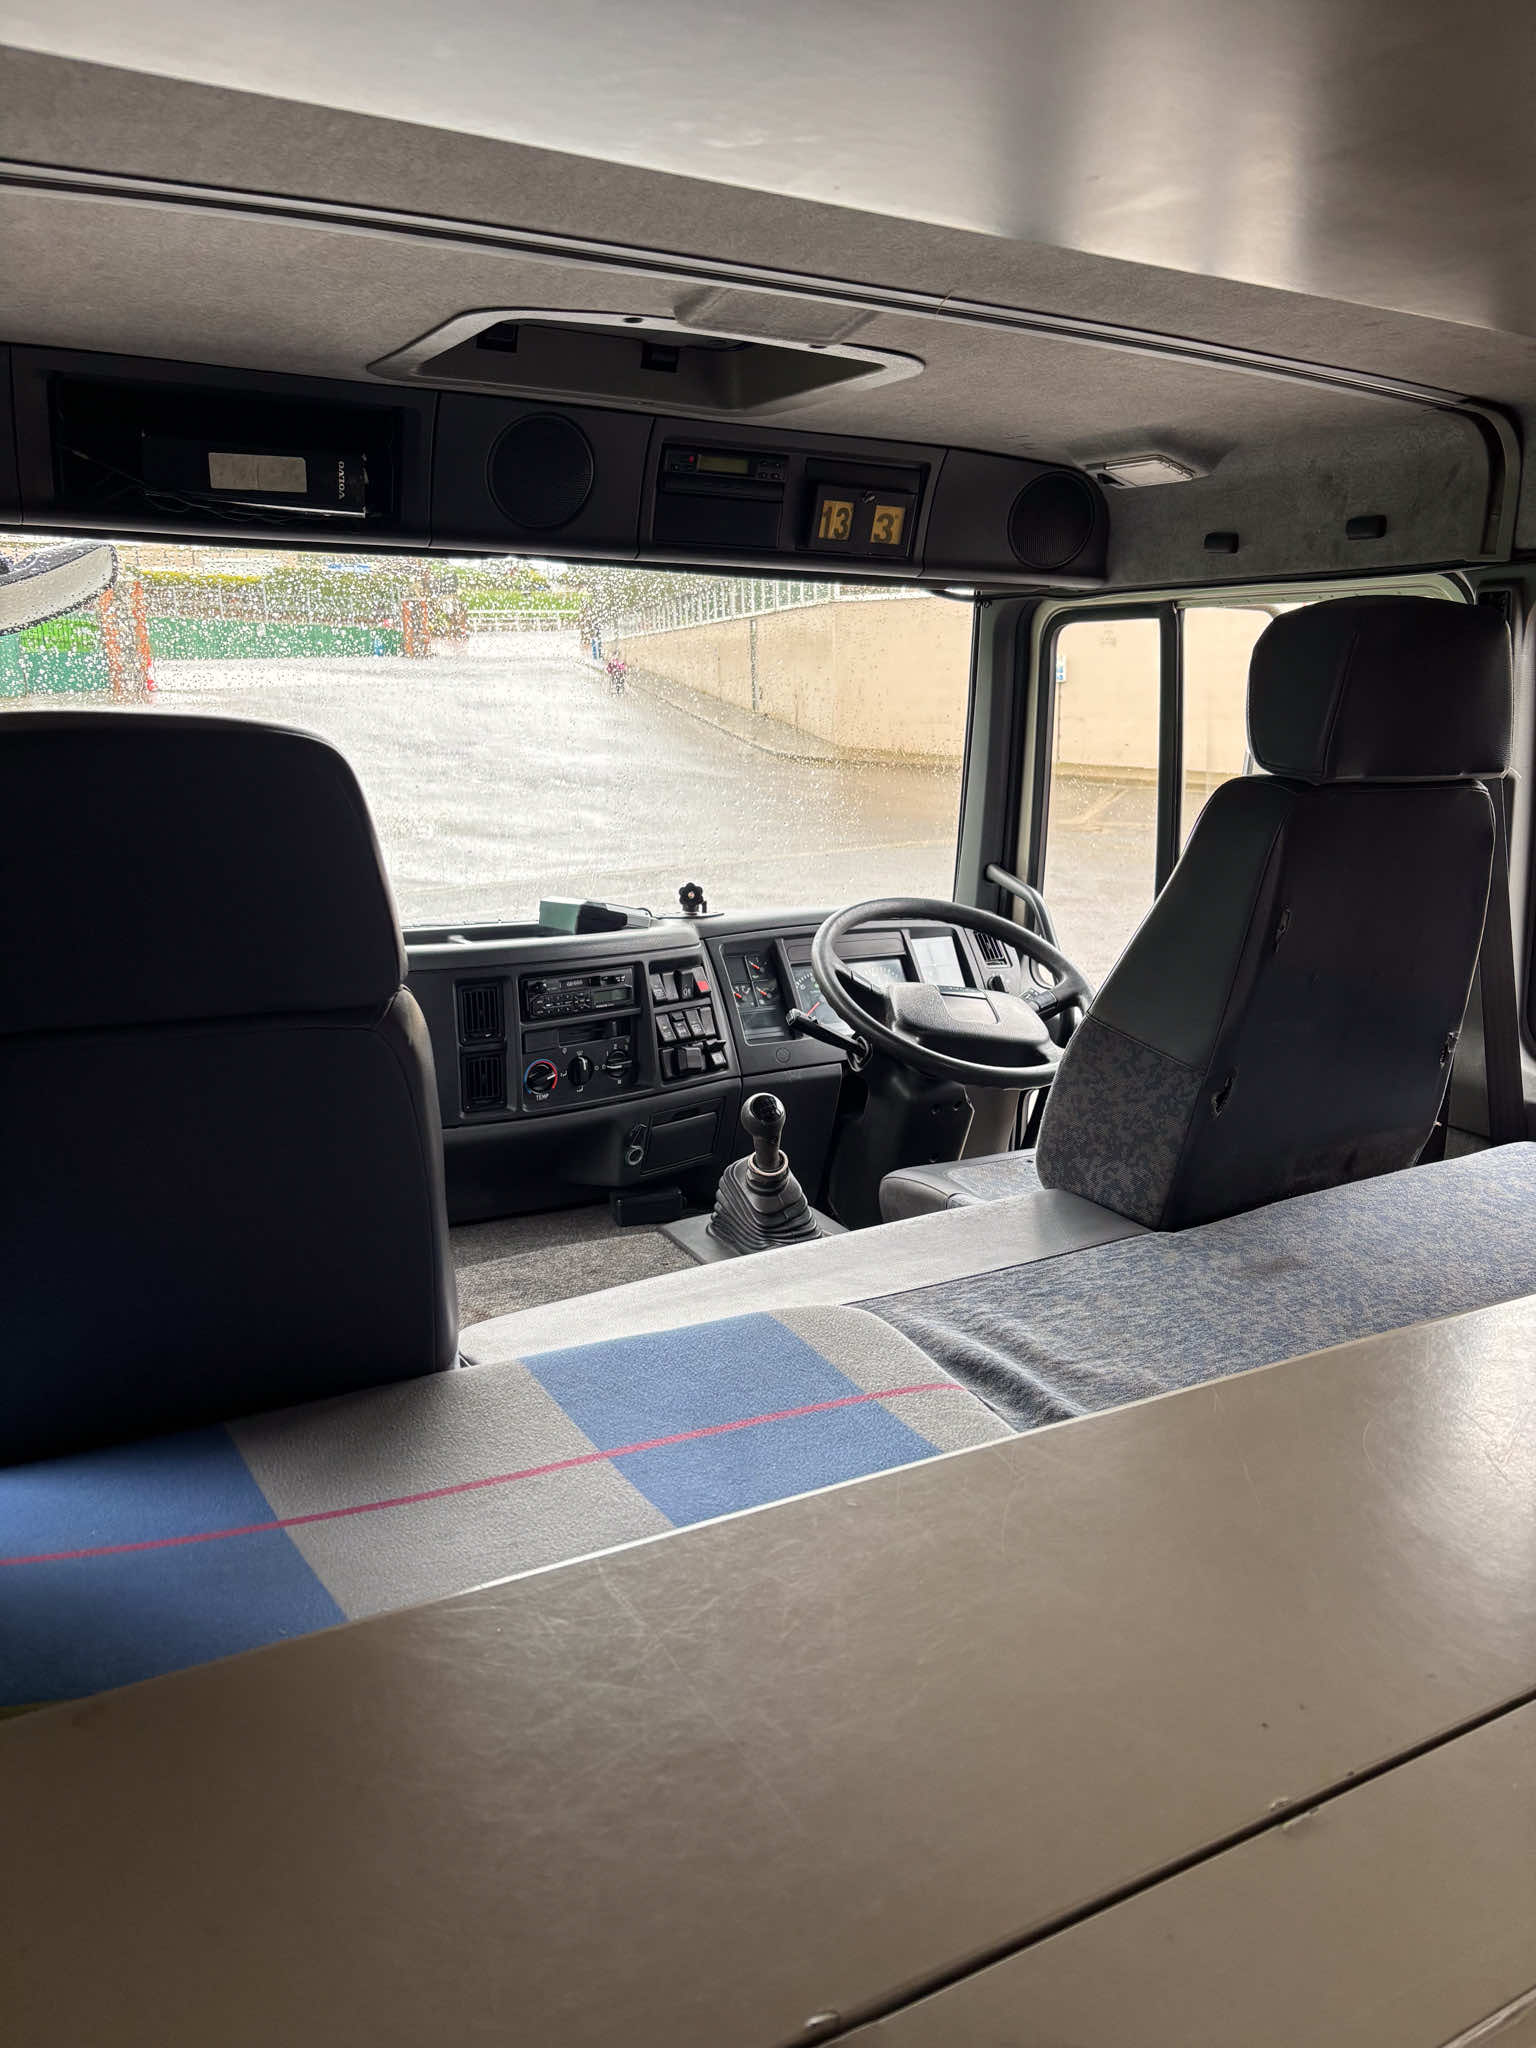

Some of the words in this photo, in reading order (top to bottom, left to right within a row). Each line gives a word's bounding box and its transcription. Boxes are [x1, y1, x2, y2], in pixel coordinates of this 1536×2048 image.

[823, 506, 850, 540] 13
[873, 512, 895, 543] 3
[535, 1093, 550, 1101] TEMP
